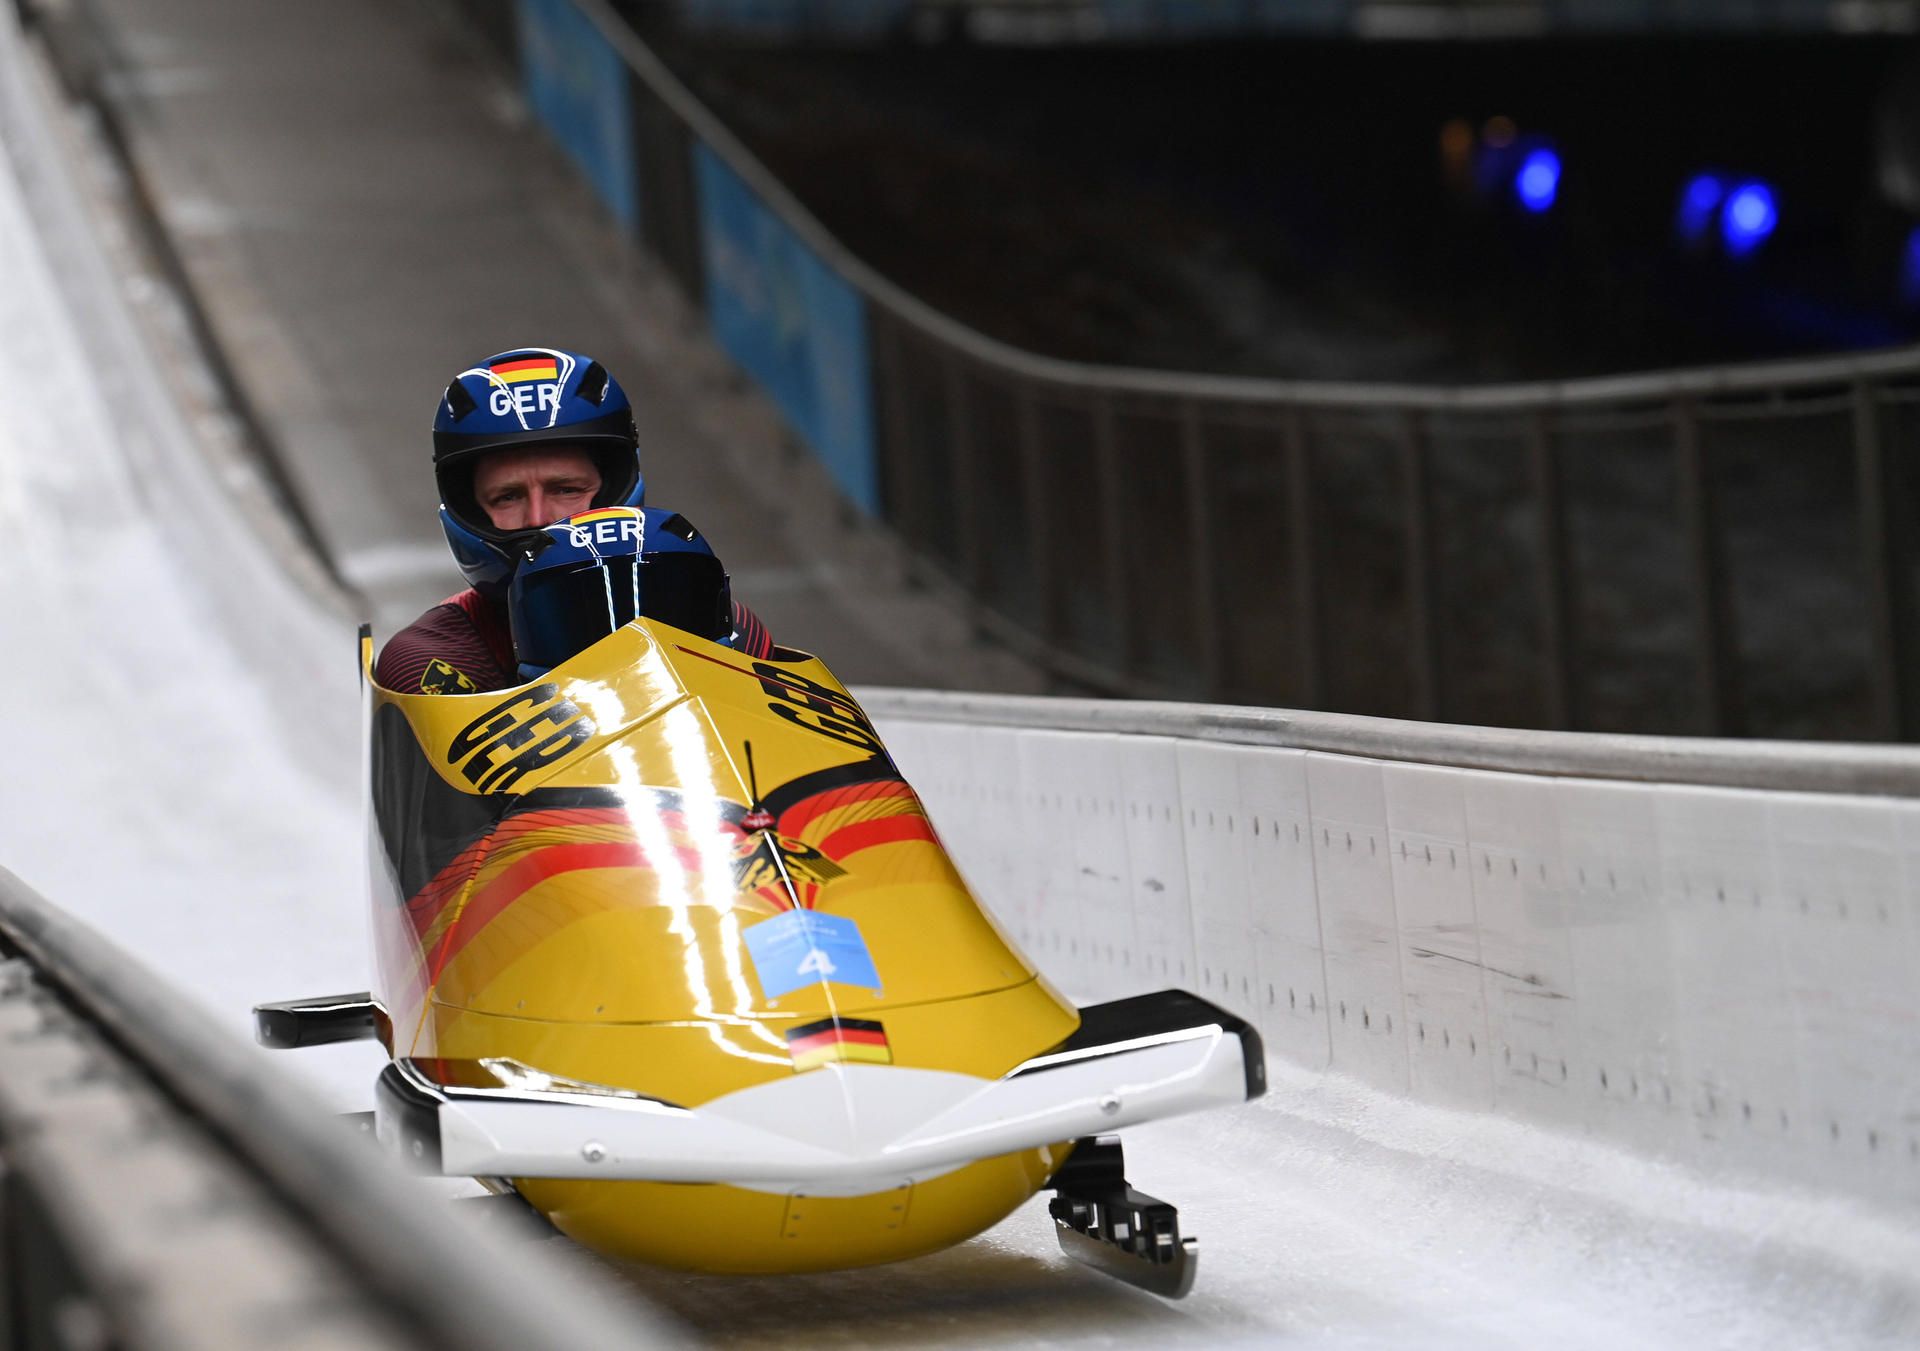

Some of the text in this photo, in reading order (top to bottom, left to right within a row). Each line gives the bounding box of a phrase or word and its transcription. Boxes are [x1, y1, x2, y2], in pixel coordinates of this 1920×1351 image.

[489, 383, 561, 416] GER
[570, 520, 645, 548] GER
[752, 662, 881, 754] GER
[447, 683, 596, 794] GER
[797, 947, 837, 976] 4
